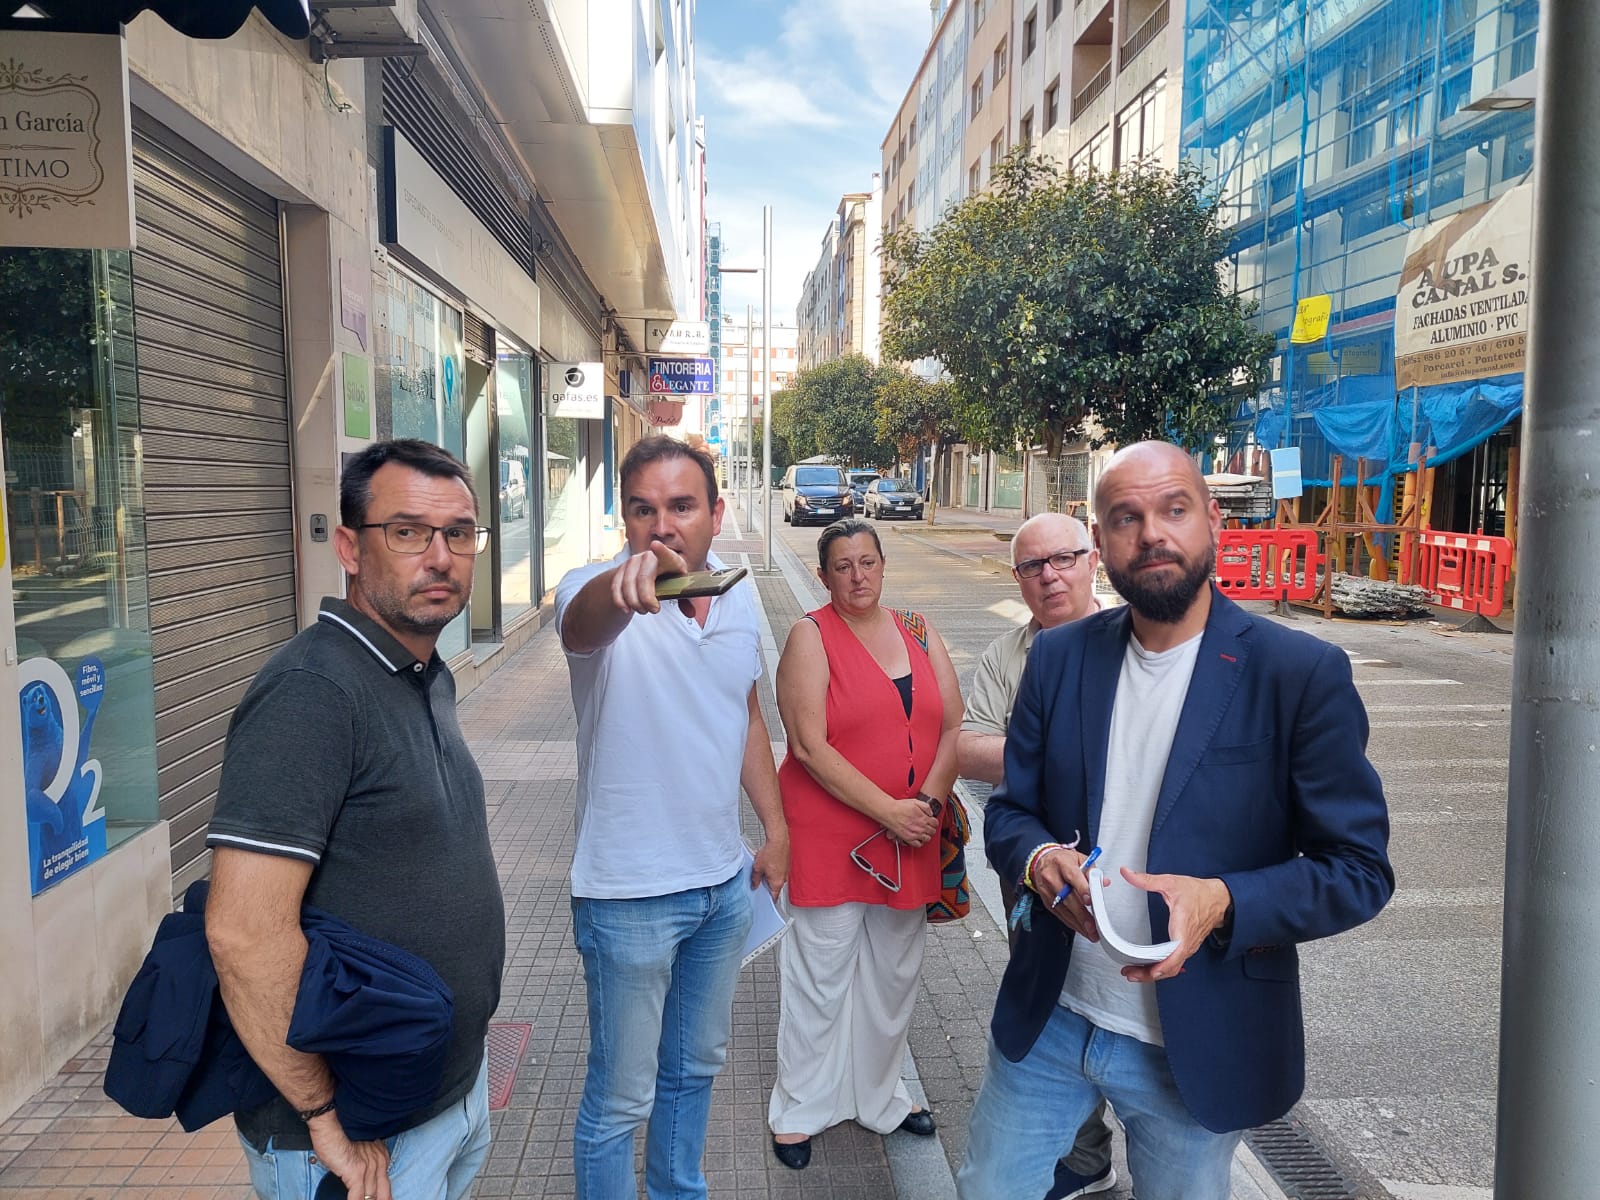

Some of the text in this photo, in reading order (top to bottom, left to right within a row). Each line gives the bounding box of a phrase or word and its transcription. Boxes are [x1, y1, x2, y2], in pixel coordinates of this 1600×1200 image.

[16, 110, 85, 132] García
[1417, 247, 1499, 290] AUPA
[1412, 271, 1497, 309] CANAL
[1413, 304, 1467, 330] FACHADAS
[1430, 319, 1487, 344] ALUMINIO
[1496, 312, 1519, 331] PVC
[1460, 347, 1472, 357] 57
[1496, 339, 1515, 350] 670
[653, 361, 712, 376] TINTORERIA
[652, 374, 710, 391] ELEGANTE
[552, 391, 599, 403] gafas.es
[81, 674, 96, 686] móvil
[43, 835, 89, 868] La tranquilidad
[44, 848, 89, 880] de elegir bien
